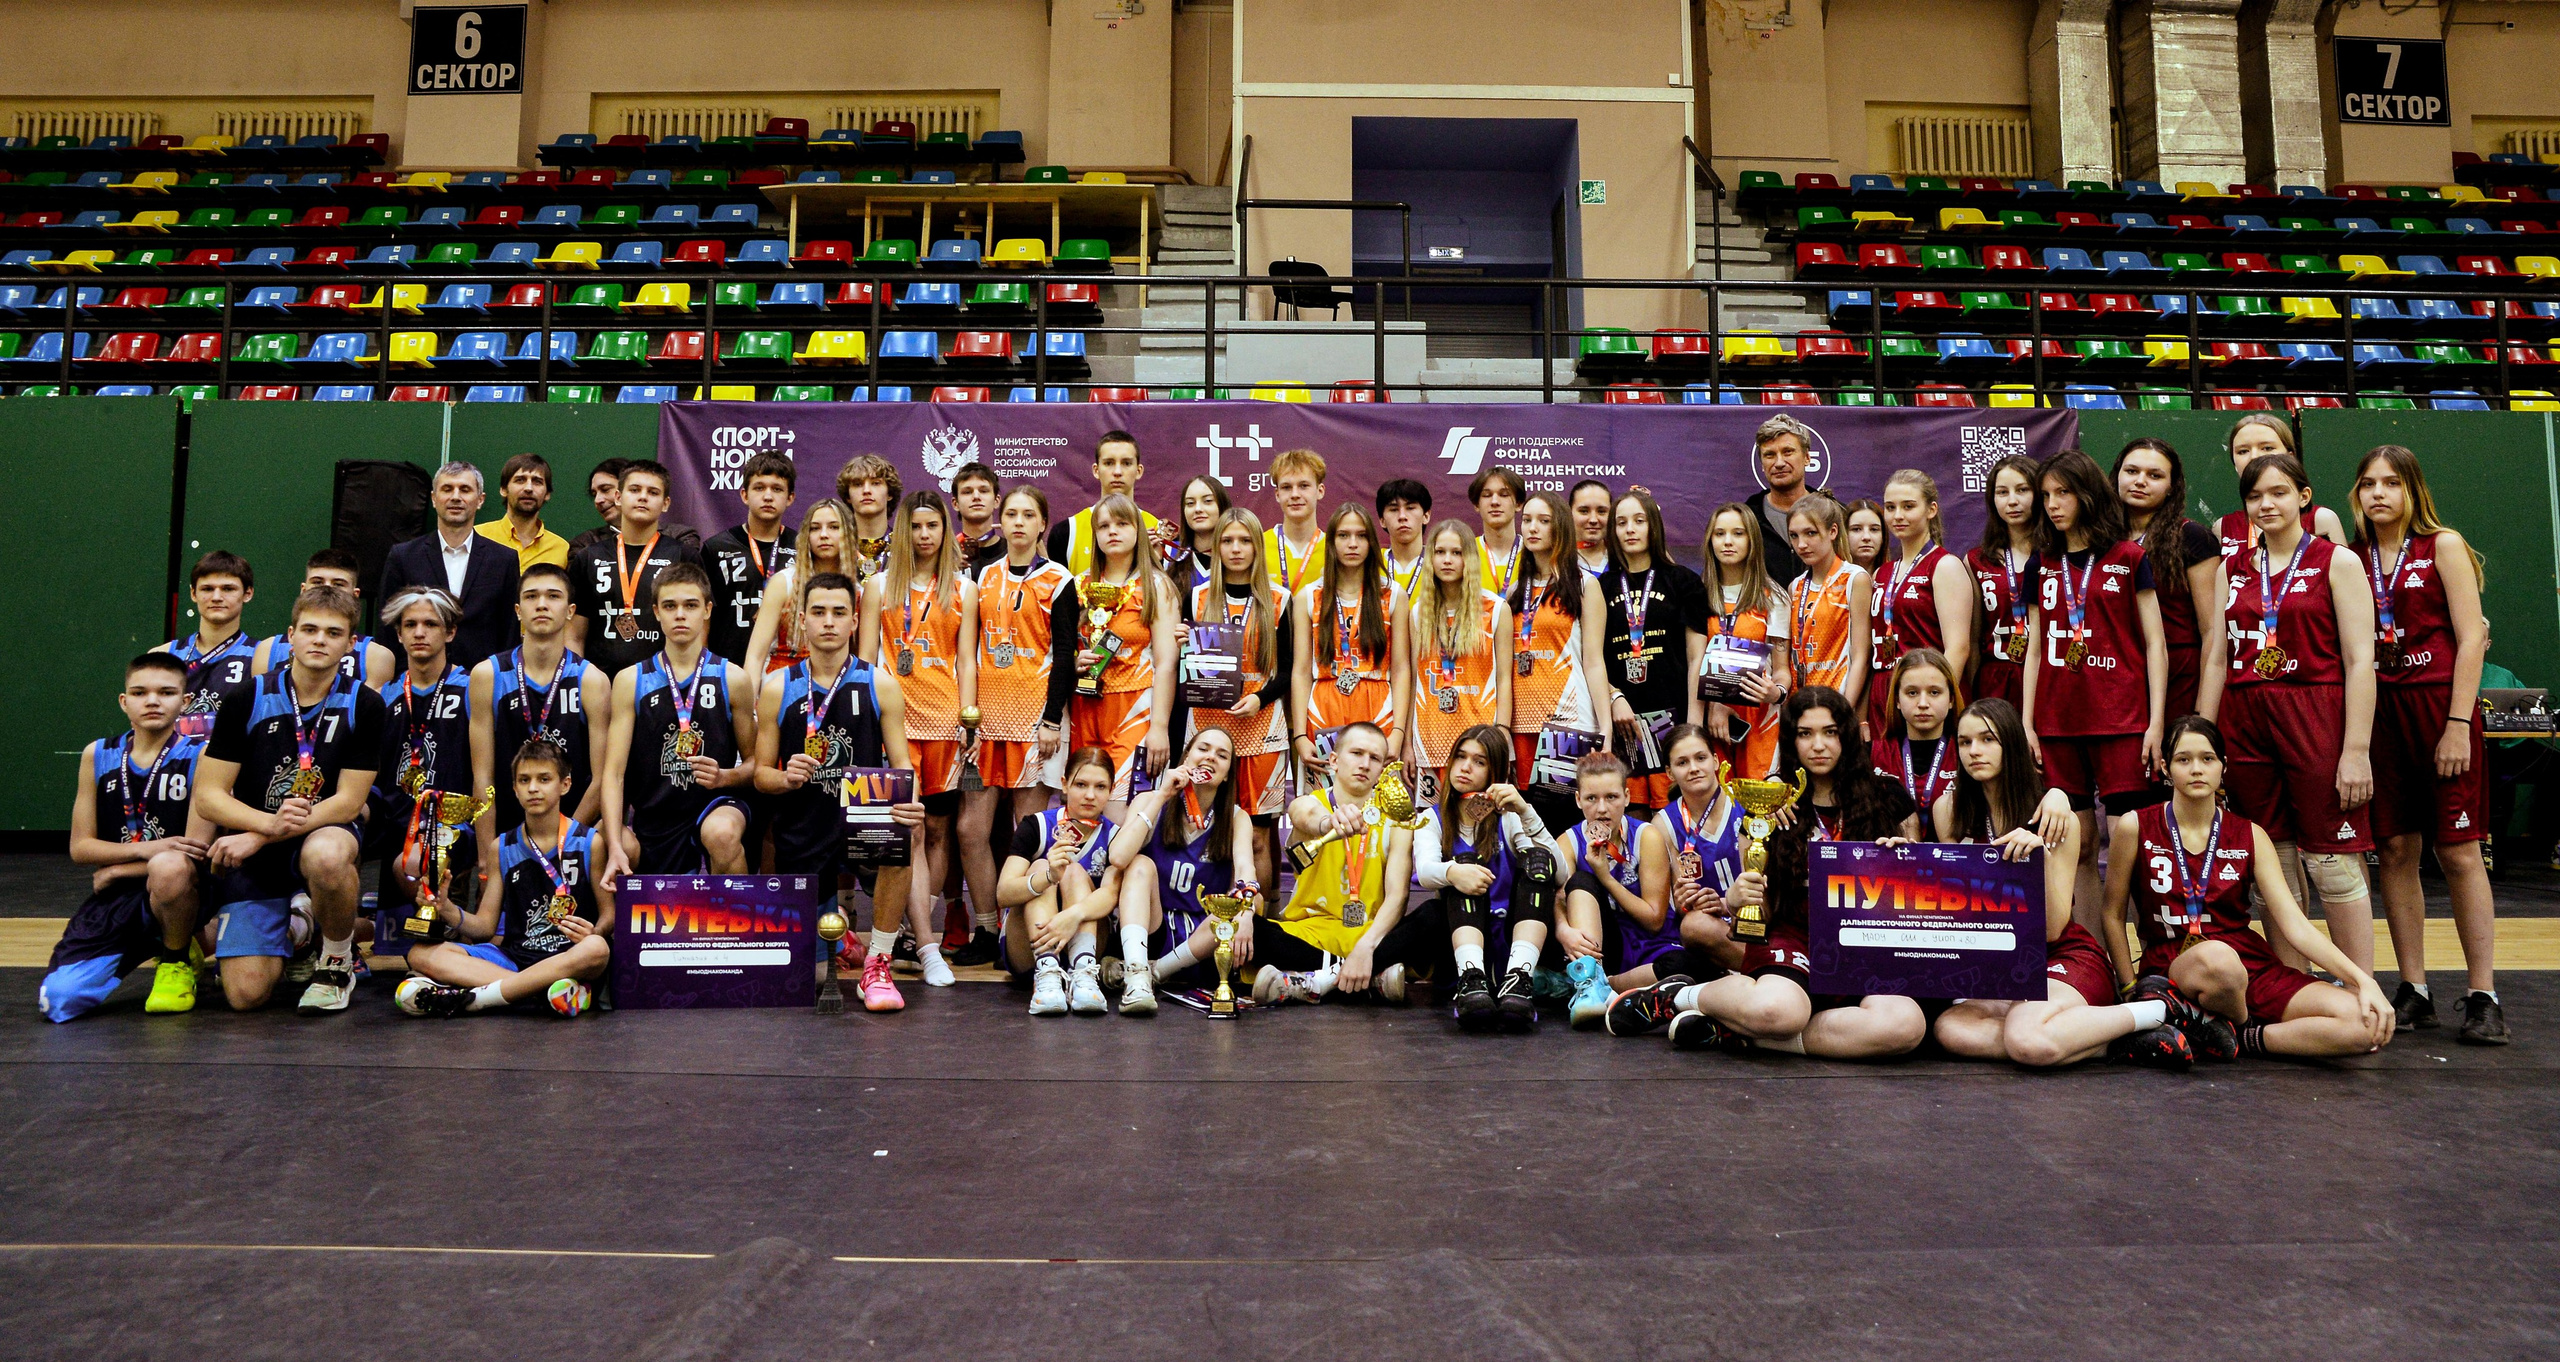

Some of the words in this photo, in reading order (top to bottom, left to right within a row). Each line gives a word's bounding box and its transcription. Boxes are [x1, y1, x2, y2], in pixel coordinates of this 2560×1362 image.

[455, 12, 482, 59] 6
[416, 63, 515, 90] СЕКТОР
[2376, 44, 2401, 90] 7
[2345, 92, 2440, 120] СЕКТОР
[711, 427, 780, 447] СПОРТ
[994, 438, 1068, 446] МИНИСТЕРСТВО
[1494, 437, 1516, 446] ПРИ
[1518, 437, 1584, 447] ПОДДЕРЖКЕ
[994, 448, 1031, 457] СПОРТА
[994, 457, 1057, 467] РОССИЙСКОЙ
[1494, 448, 1552, 461] ФОНДА
[994, 469, 1049, 478] ФЕДЕРАЦИИ
[1524, 481, 1564, 492] НТОВ
[596, 567, 612, 593] 5
[718, 556, 747, 586] 12
[2043, 577, 2059, 611] 9
[225, 661, 244, 683] 3
[434, 694, 461, 719] 12
[700, 684, 716, 709] 8
[851, 690, 860, 715] 1
[323, 715, 340, 743] 7
[663, 761, 692, 773] АЙСБЕ
[812, 768, 842, 780] АЙСБЕ
[158, 773, 187, 801] 18
[1422, 775, 1436, 798] 3
[2207, 834, 2216, 852] ОДНА
[2337, 829, 2357, 840] PEAK
[1169, 860, 1196, 893] 10
[2150, 855, 2173, 894] 3
[2200, 851, 2212, 879] КОМАНДА
[1827, 868, 2029, 913] ПУТЁВКА
[218, 913, 231, 941] 7
[630, 897, 802, 934] ПУТЁВКА
[1840, 919, 1921, 928] ДАЛЬНЕВОСТОЧНОГО
[1922, 921, 1983, 929] ФЕДЕРАЛЬНОГО
[1984, 922, 2014, 930] ОКРУГА
[1894, 951, 1960, 959] #МЫОДНАКОМАНДА
